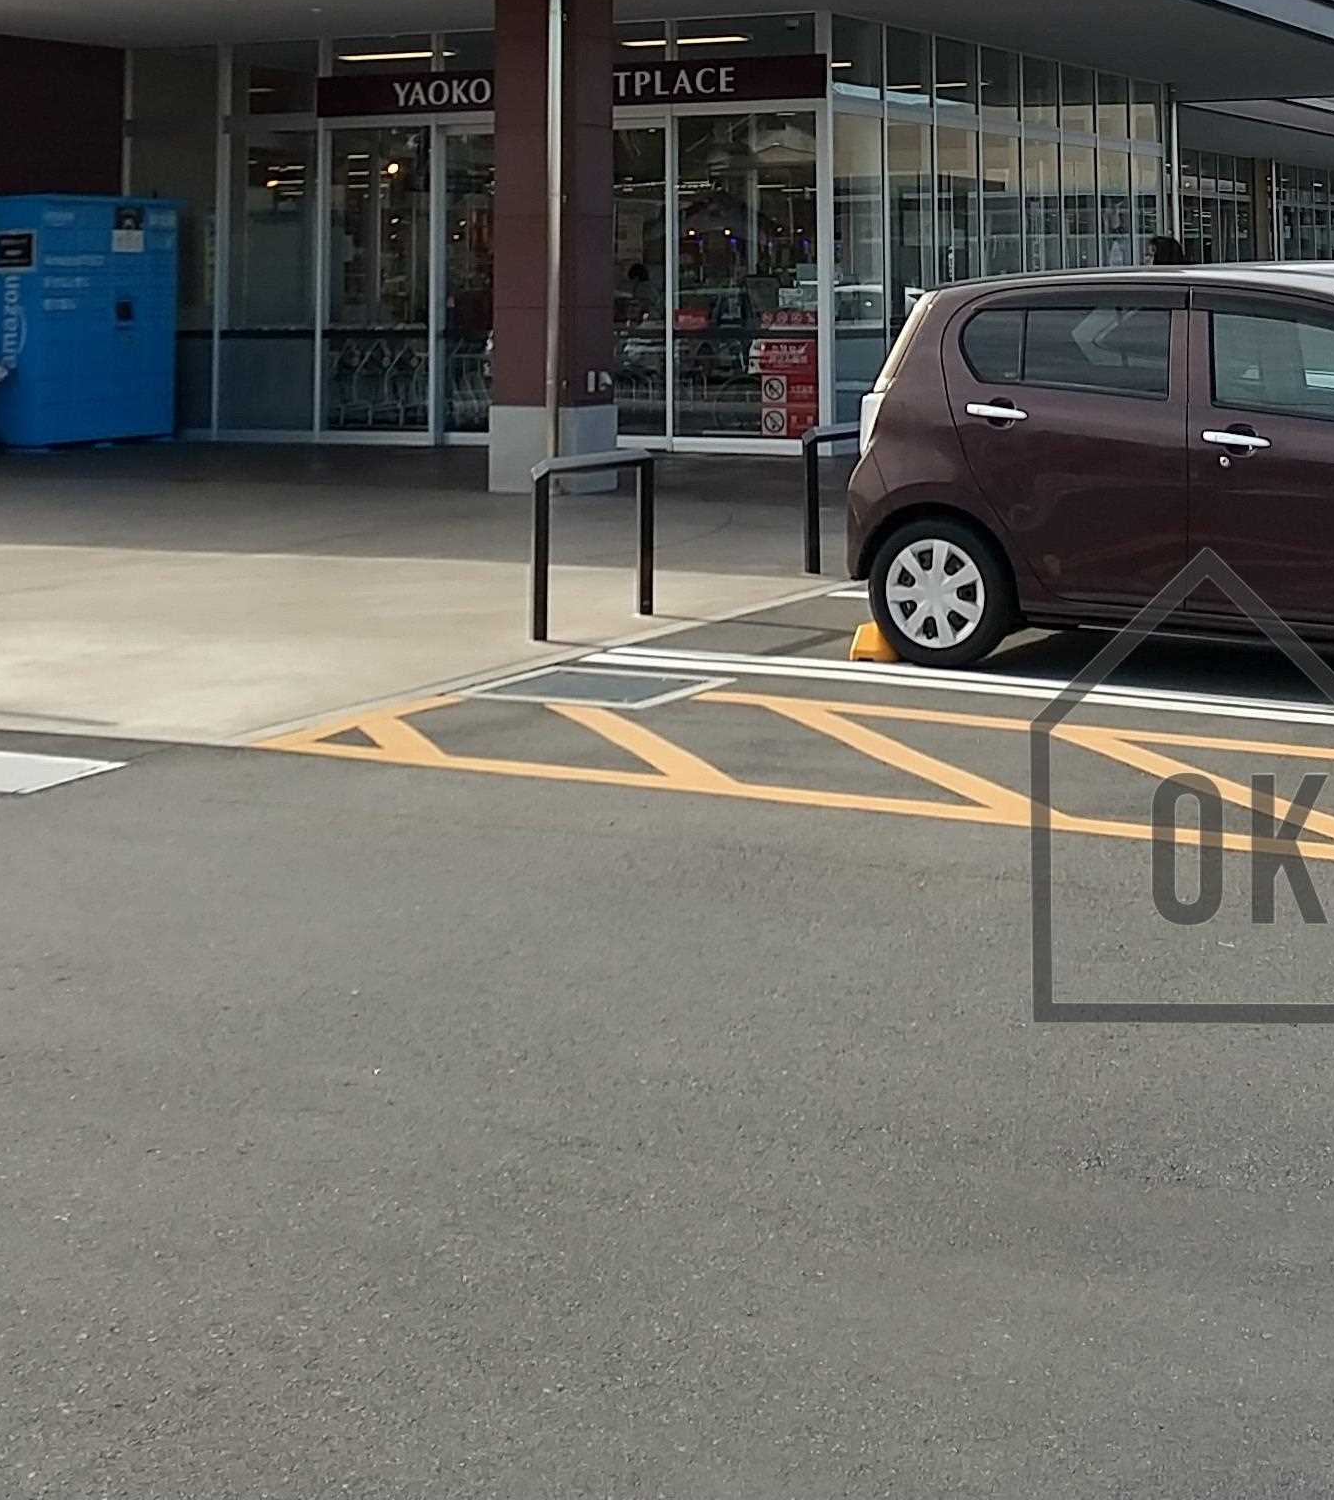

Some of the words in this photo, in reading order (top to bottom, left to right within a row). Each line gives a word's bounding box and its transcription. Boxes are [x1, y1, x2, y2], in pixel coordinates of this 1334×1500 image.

[392, 77, 492, 107] YAOKO
[613, 66, 735, 97] TPLACE
[2, 275, 22, 369] amazon
